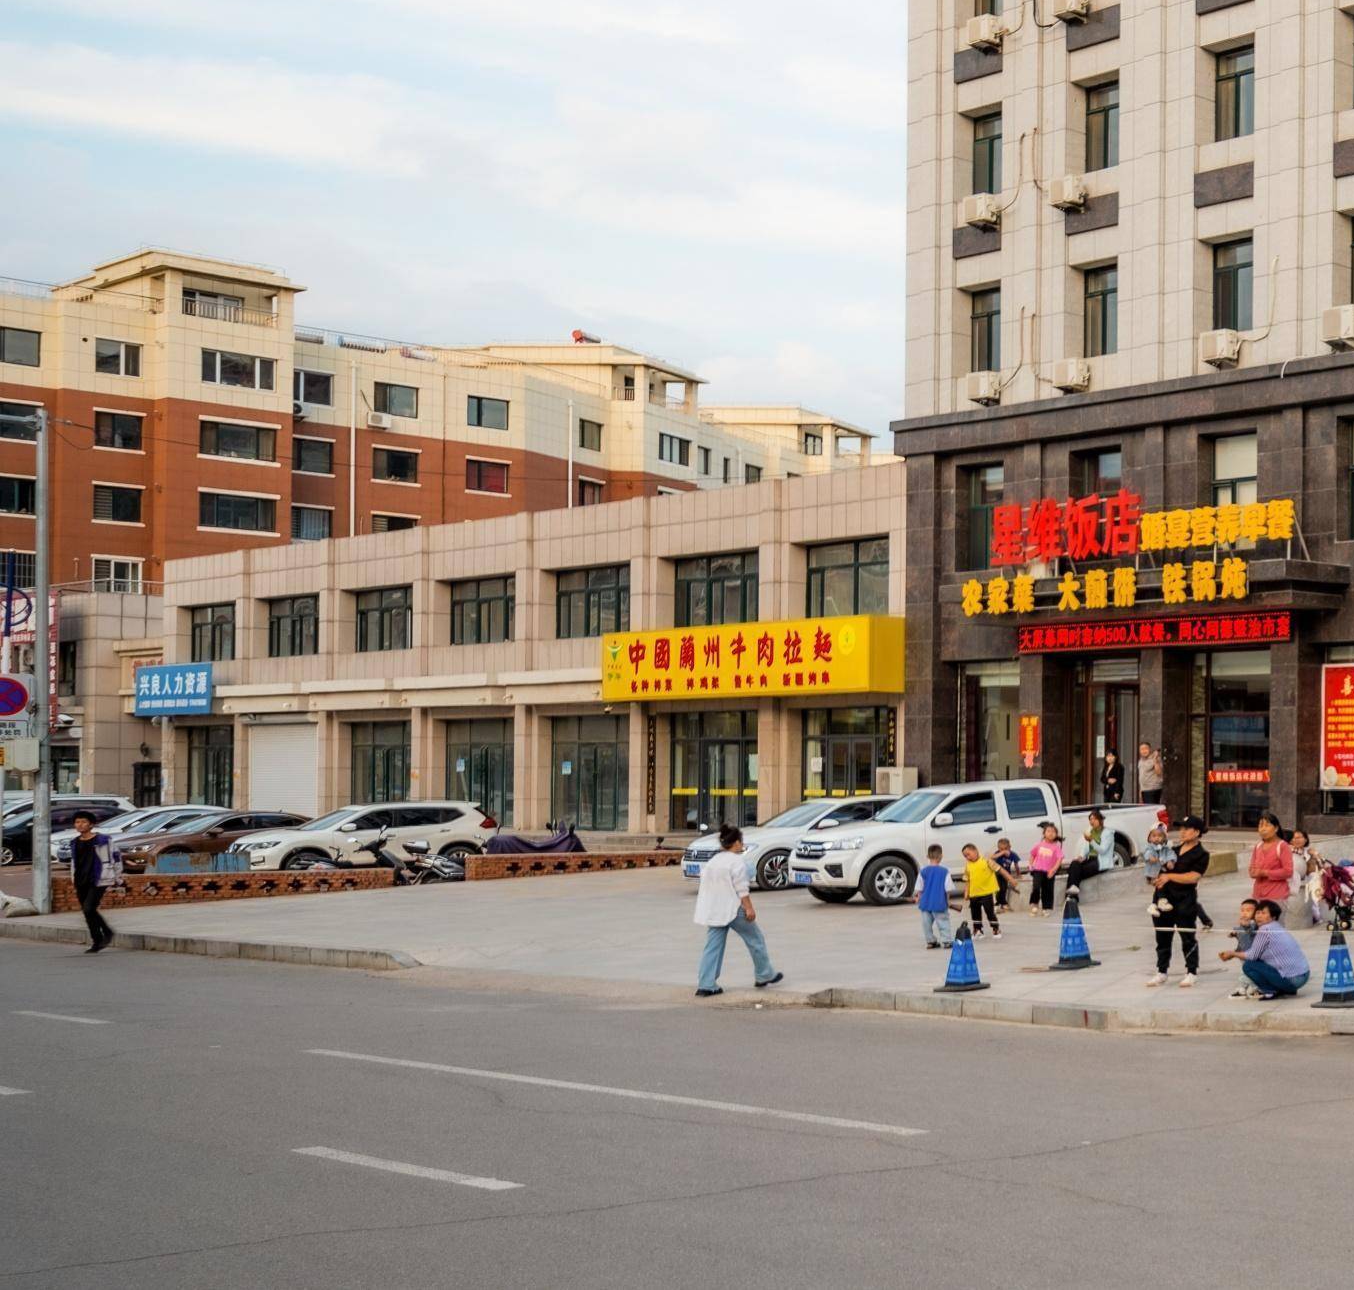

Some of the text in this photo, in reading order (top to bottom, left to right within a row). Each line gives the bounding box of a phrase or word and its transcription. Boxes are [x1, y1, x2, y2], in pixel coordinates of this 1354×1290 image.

[990, 488, 1295, 566] 星维饭店 婚宴营养早餐
[962, 557, 1247, 617] 农家菜 大煎饼 铁锅炖
[139, 671, 208, 697] 兴良人力资源
